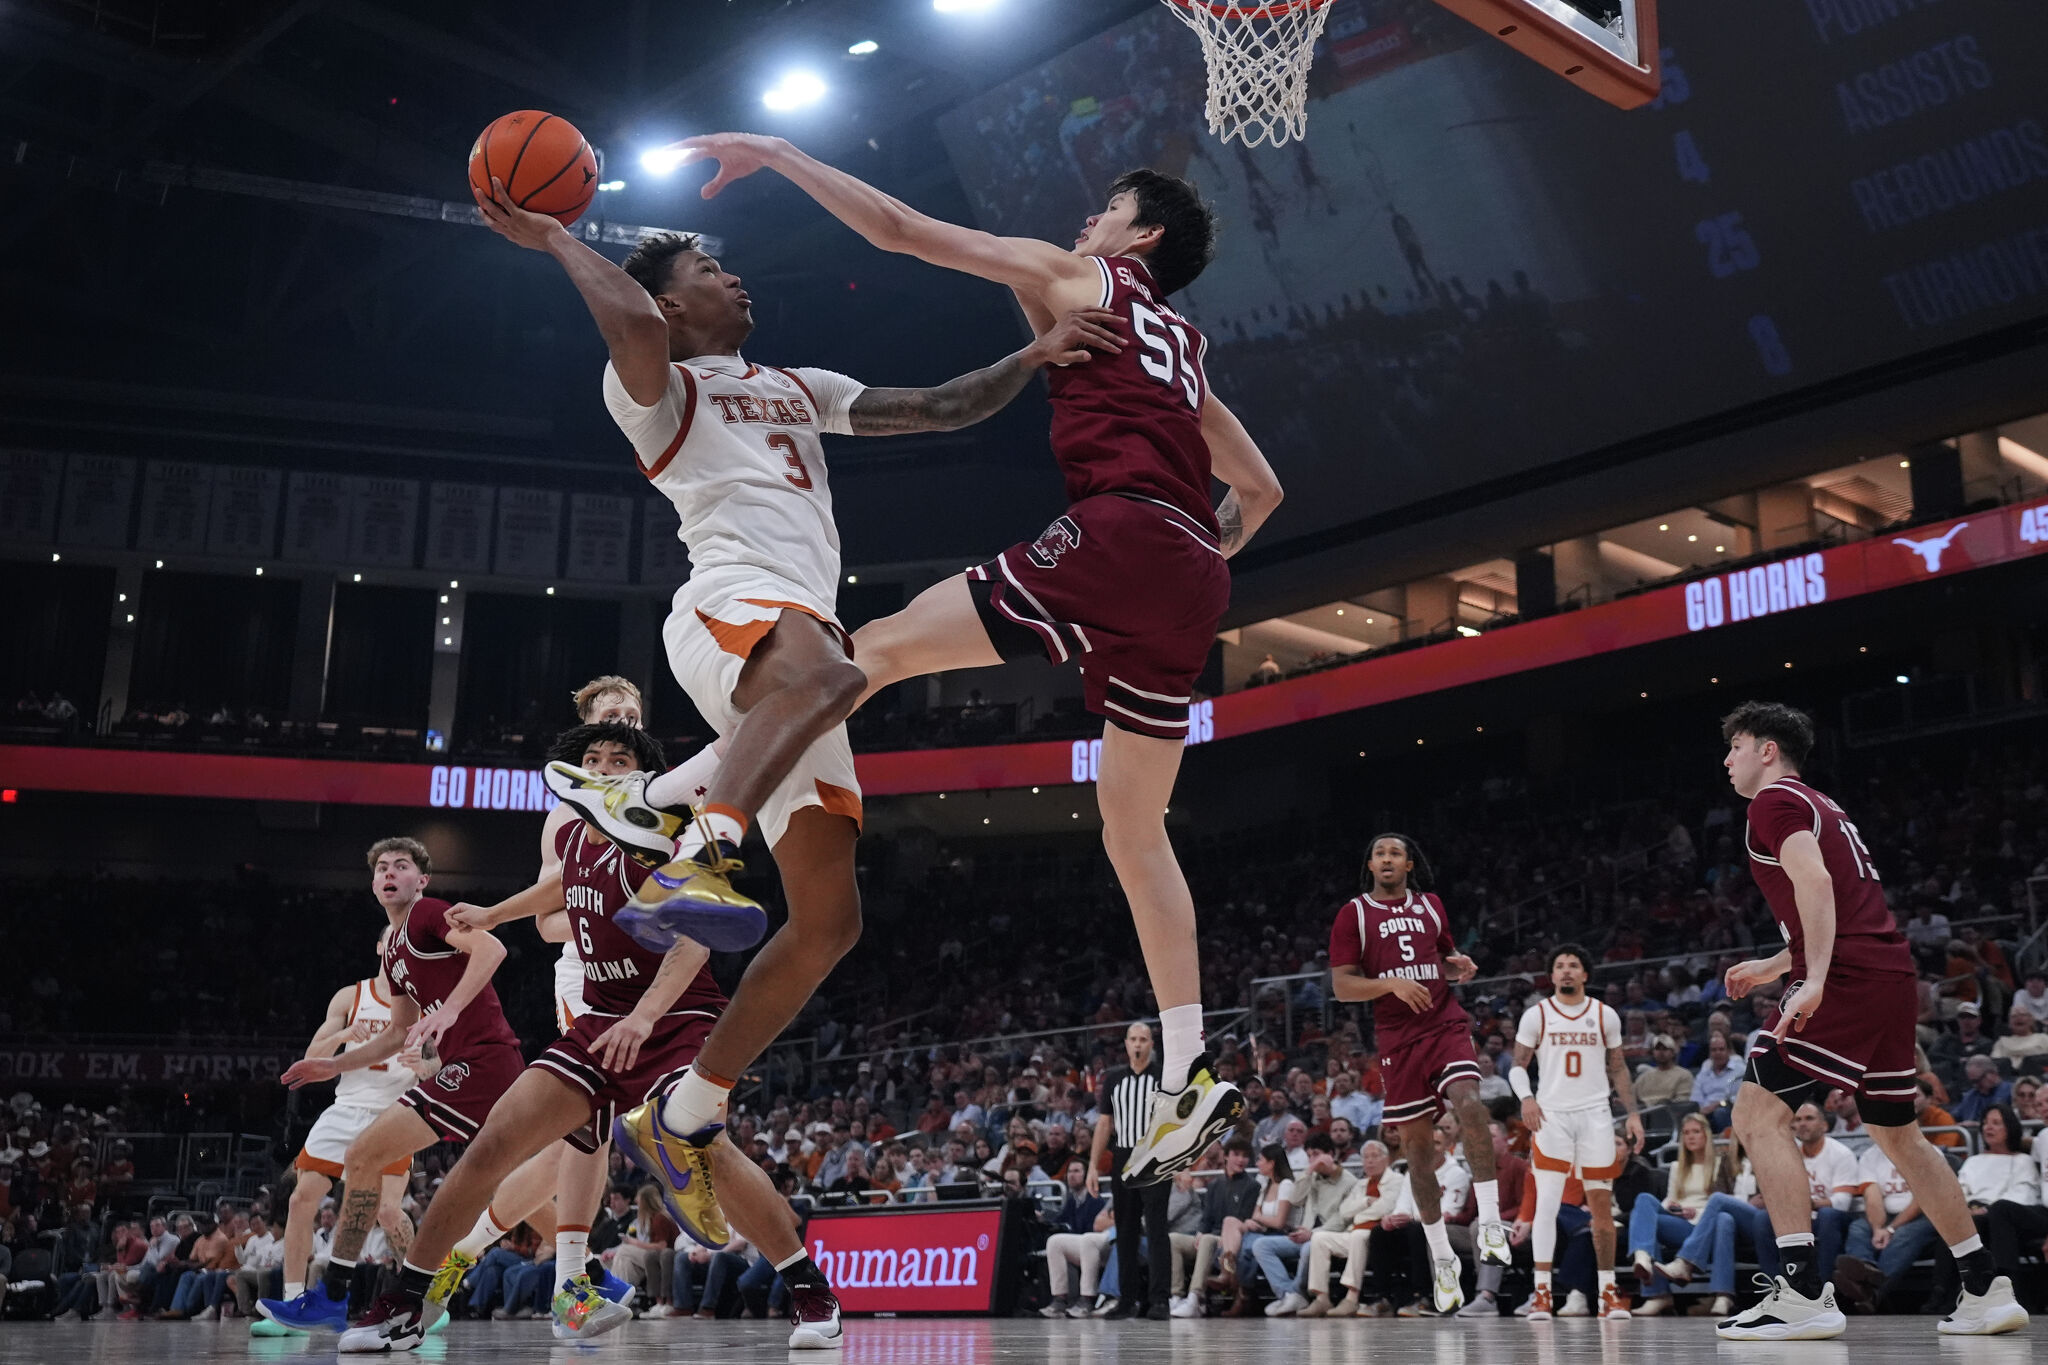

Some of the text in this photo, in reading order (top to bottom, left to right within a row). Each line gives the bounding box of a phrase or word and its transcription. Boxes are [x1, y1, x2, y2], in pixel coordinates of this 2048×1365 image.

[1836, 33, 1993, 135] ASSISTS
[1673, 129, 1711, 183] 4
[1850, 118, 2048, 233] REBOUNDS
[1695, 210, 1761, 279] 25
[708, 393, 814, 425] TEXAS
[765, 431, 814, 493] 3
[1684, 551, 1827, 632] GO HORNS
[429, 765, 468, 809] GO
[566, 885, 604, 917] SOUTH
[578, 917, 594, 955] 6
[1378, 917, 1426, 939] SOUTH
[1397, 934, 1416, 962] 5
[584, 957, 640, 982] OLINA
[1548, 1032, 1598, 1046] TEXAS
[1566, 1051, 1582, 1078] 0
